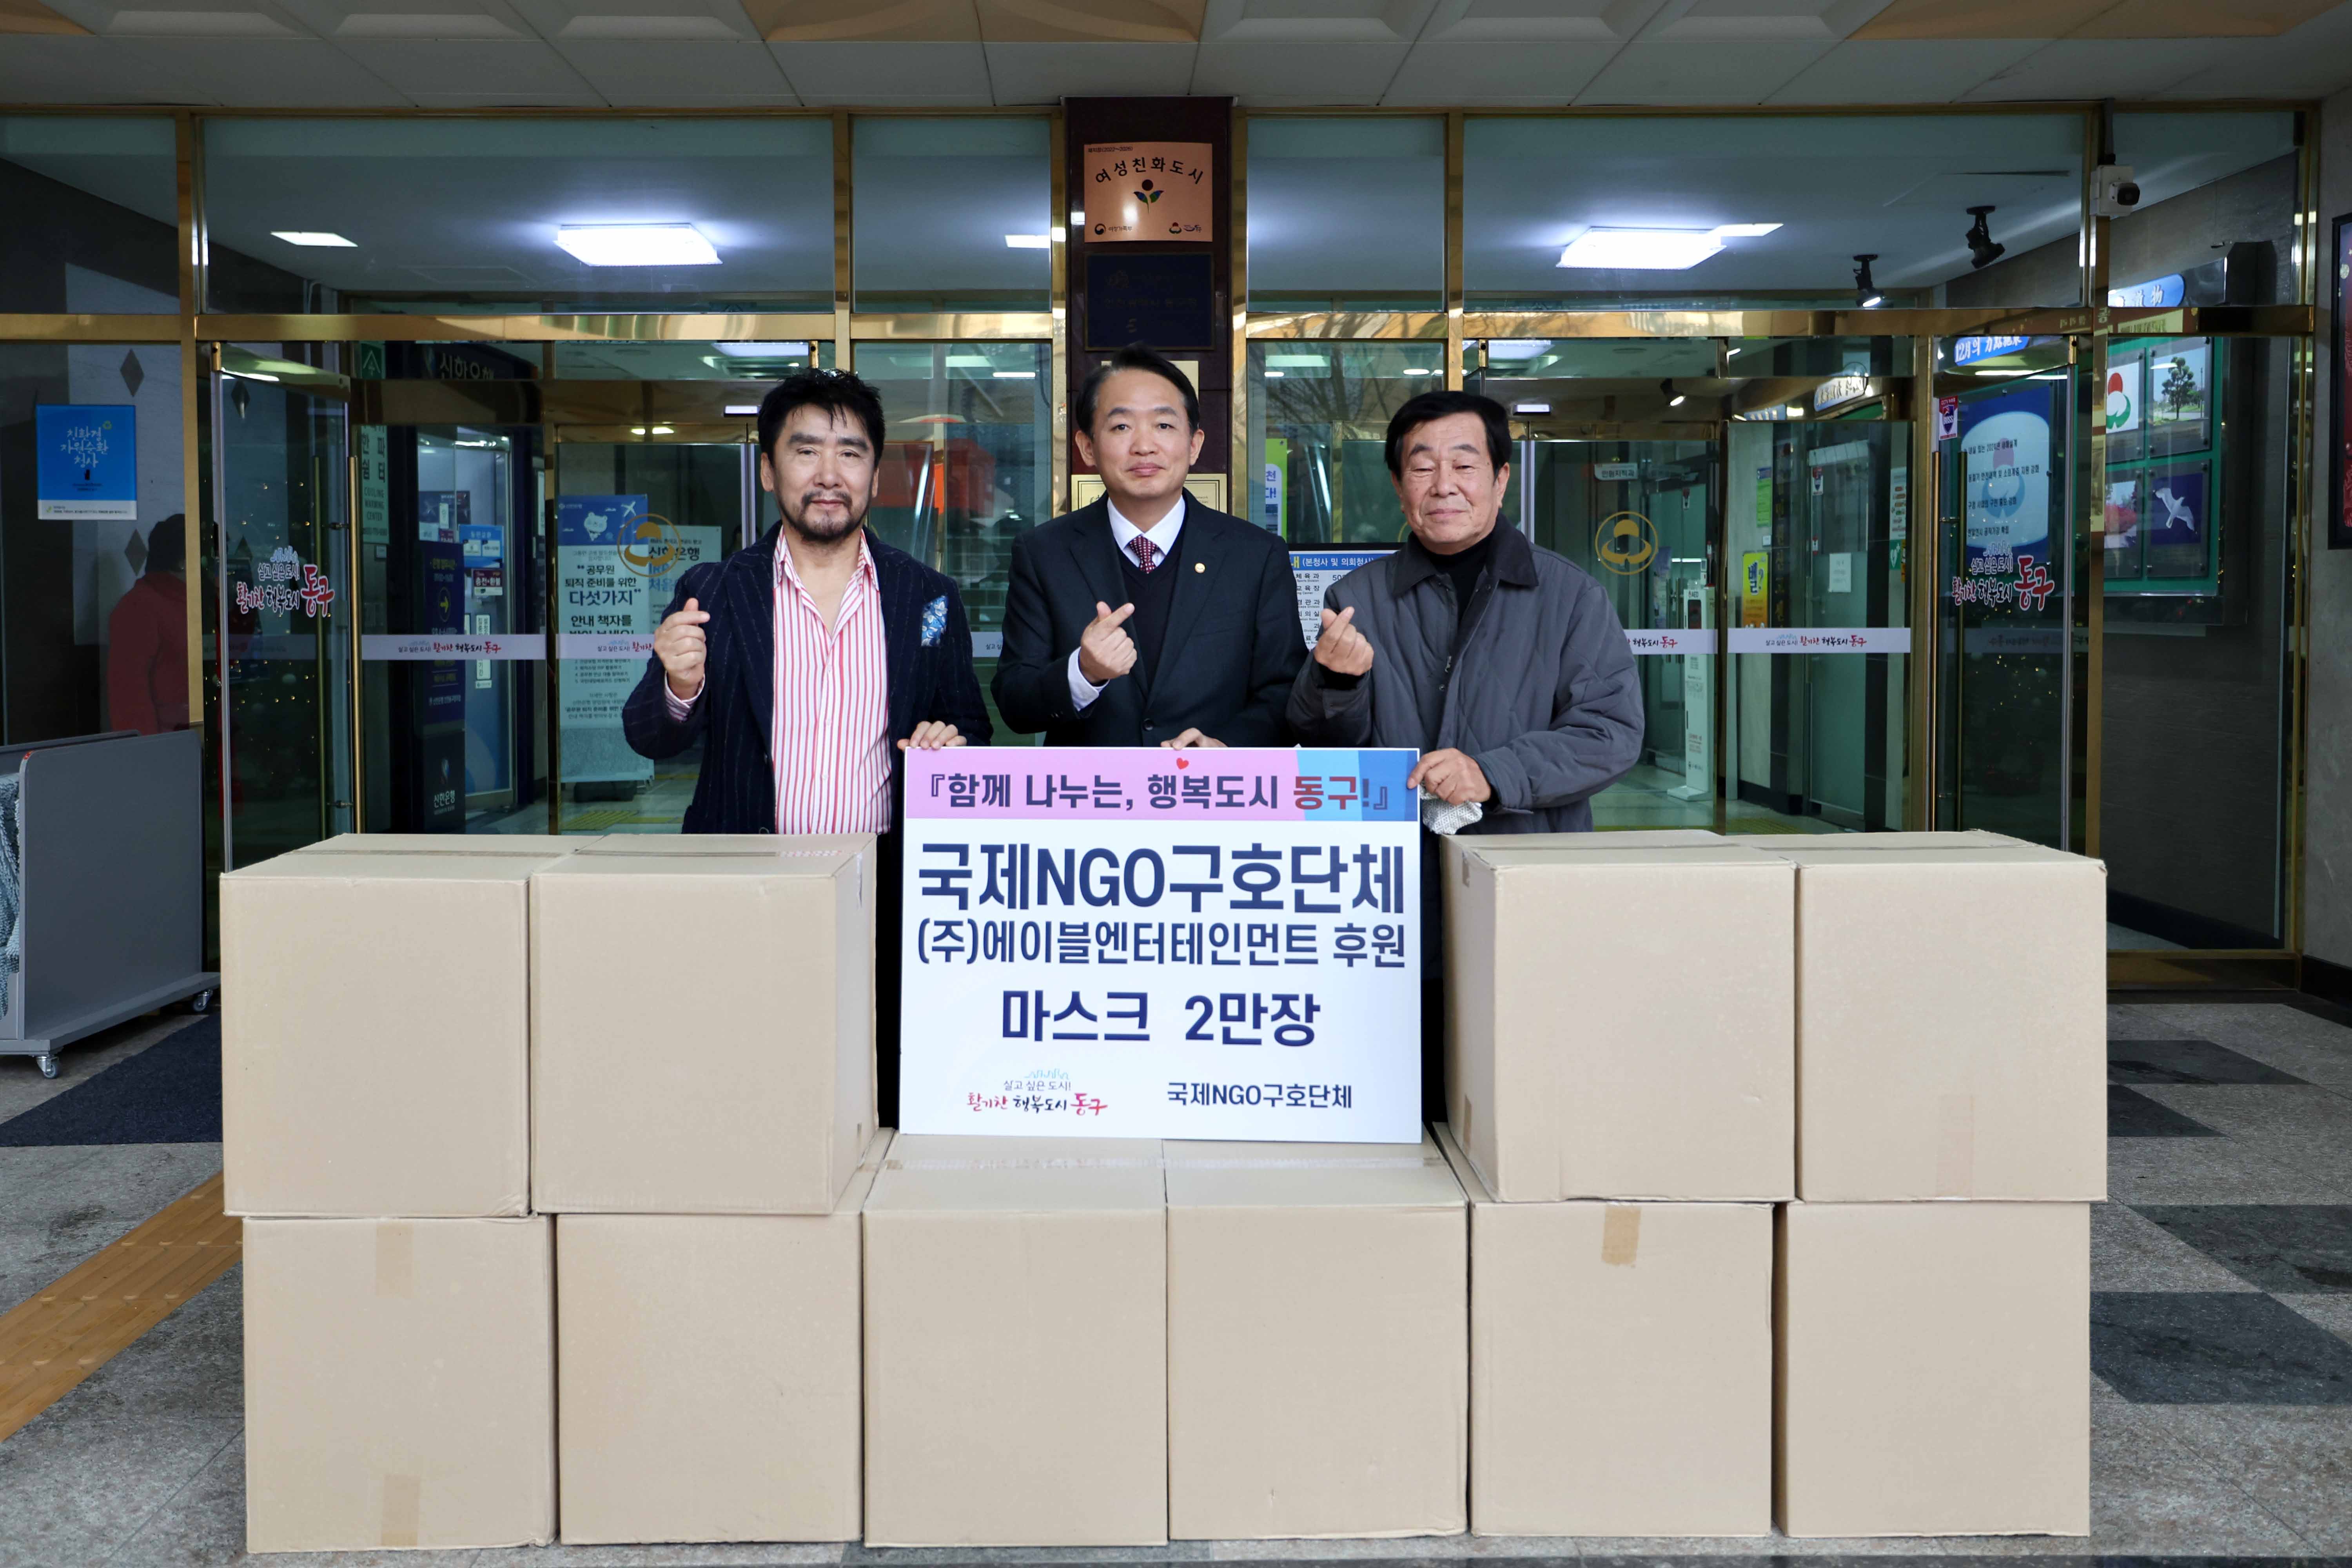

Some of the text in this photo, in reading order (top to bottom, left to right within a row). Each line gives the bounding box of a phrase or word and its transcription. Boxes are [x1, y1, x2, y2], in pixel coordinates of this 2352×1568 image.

[1095, 157, 1203, 184] 여성친화도시
[60, 439, 109, 455] 자원순환
[367, 511, 383, 521] CENTER
[1302, 558, 1328, 567] (본청사
[1331, 558, 1339, 567] 및
[1971, 556, 2013, 575] 살고 싶은 도시!
[258, 563, 300, 581] 살고 싶은 도시!
[236, 564, 335, 618] 활기찬 행복도시 동구
[565, 577, 637, 588] 퇴직 준비를 위한
[1951, 555, 2054, 612] 활기찬 행복도시 동구
[571, 615, 632, 627] 안내 책자를
[433, 642, 454, 653] 활기찬
[455, 642, 482, 653] 행복도시
[483, 641, 502, 654] 동구
[632, 641, 653, 652] 활기찬
[1632, 636, 1678, 649] 행복도시 동구
[1800, 635, 1820, 646] 활기찬
[1821, 636, 1848, 647] 행복도시
[1849, 634, 1867, 648] 동구
[930, 773, 1389, 811] 『함께 나누는, 행복도시 동구!』
[918, 843, 1404, 914] 국제NGO구호단체
[918, 918, 1405, 968] (주)에이블엔터테인먼트 후원
[1002, 990, 1321, 1047] 마스크 2만장
[1004, 1080, 1072, 1091] 살고 싶은 도시!
[967, 1092, 1108, 1116] 활기찬 행복도시 동구
[1167, 1082, 1352, 1110] 국제NGO구호단체
